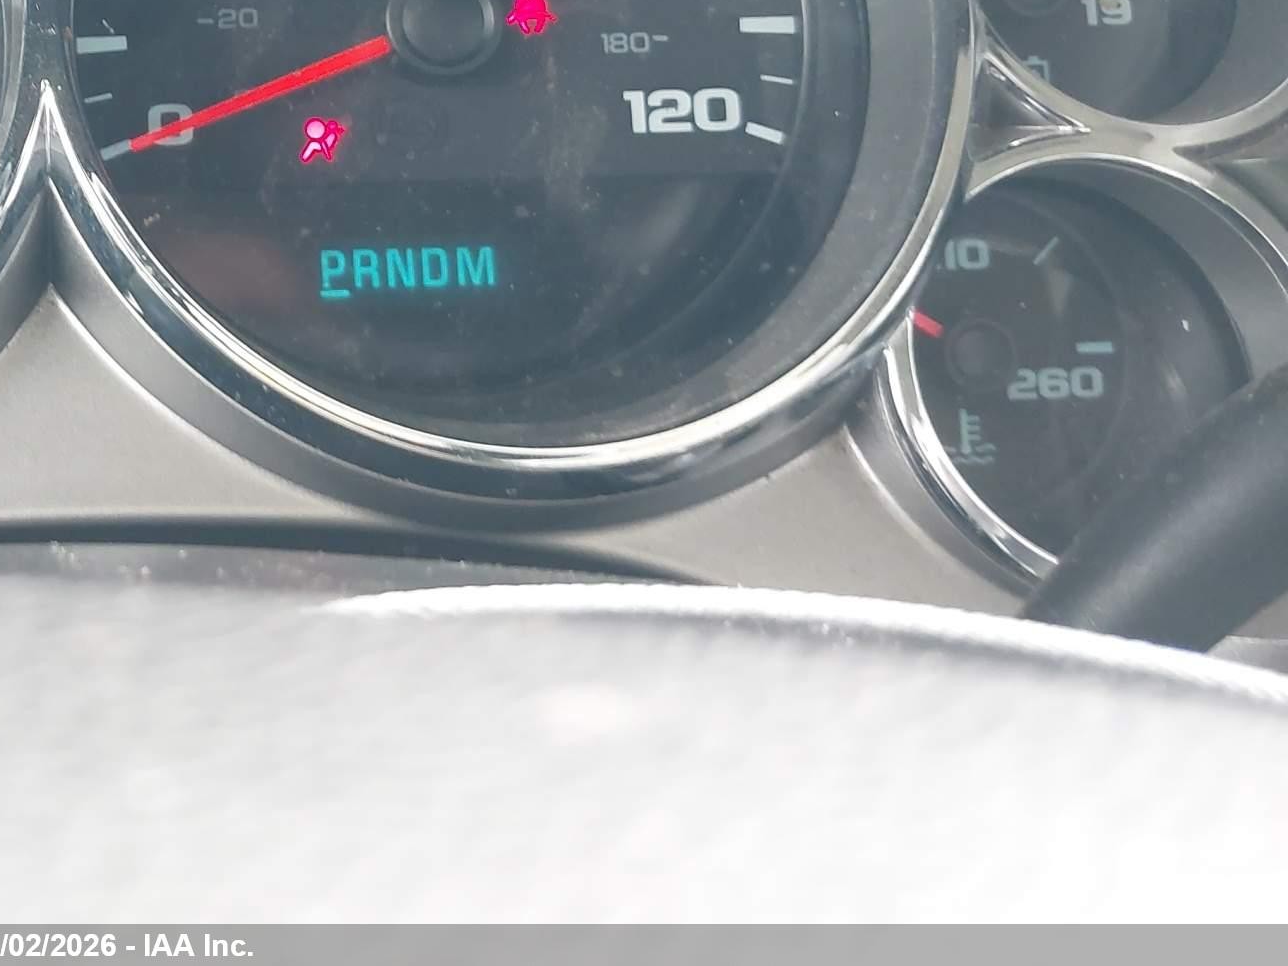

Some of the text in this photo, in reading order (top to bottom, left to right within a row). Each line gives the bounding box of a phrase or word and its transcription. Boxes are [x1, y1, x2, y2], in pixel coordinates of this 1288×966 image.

[216, 8, 259, 29] 20
[601, 33, 650, 54] 180
[147, 103, 194, 146] 0
[622, 88, 742, 134] 120
[320, 245, 497, 290] PRNDM
[1007, 366, 1104, 401] 260
